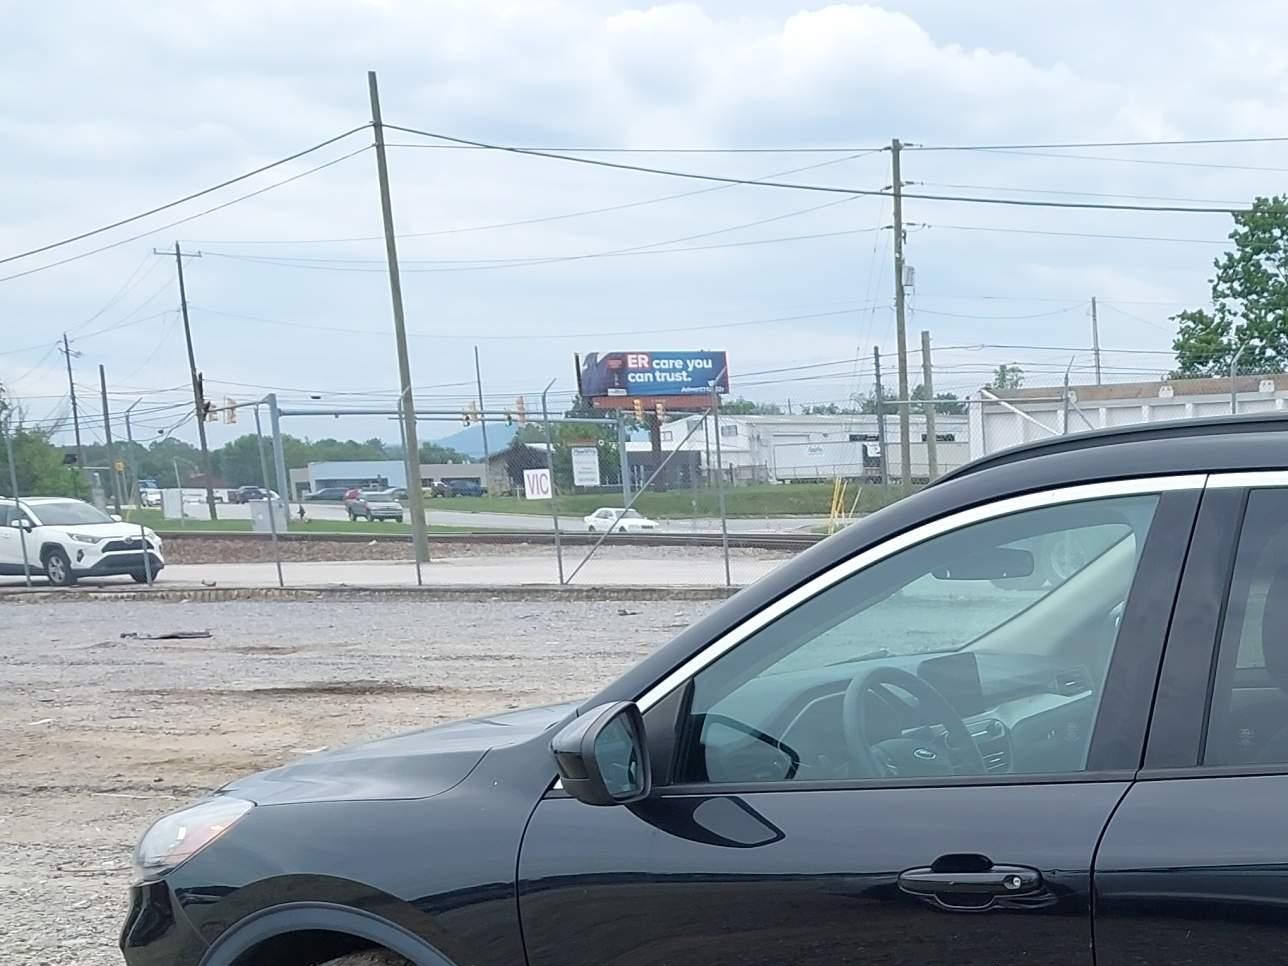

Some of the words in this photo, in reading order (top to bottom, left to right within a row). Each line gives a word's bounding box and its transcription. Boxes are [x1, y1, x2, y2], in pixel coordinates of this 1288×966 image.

[627, 354, 649, 368] ER
[652, 359, 684, 369] care
[687, 359, 712, 371] you
[627, 372, 653, 382] can
[655, 371, 692, 382] trust.
[526, 473, 549, 495] VIC
